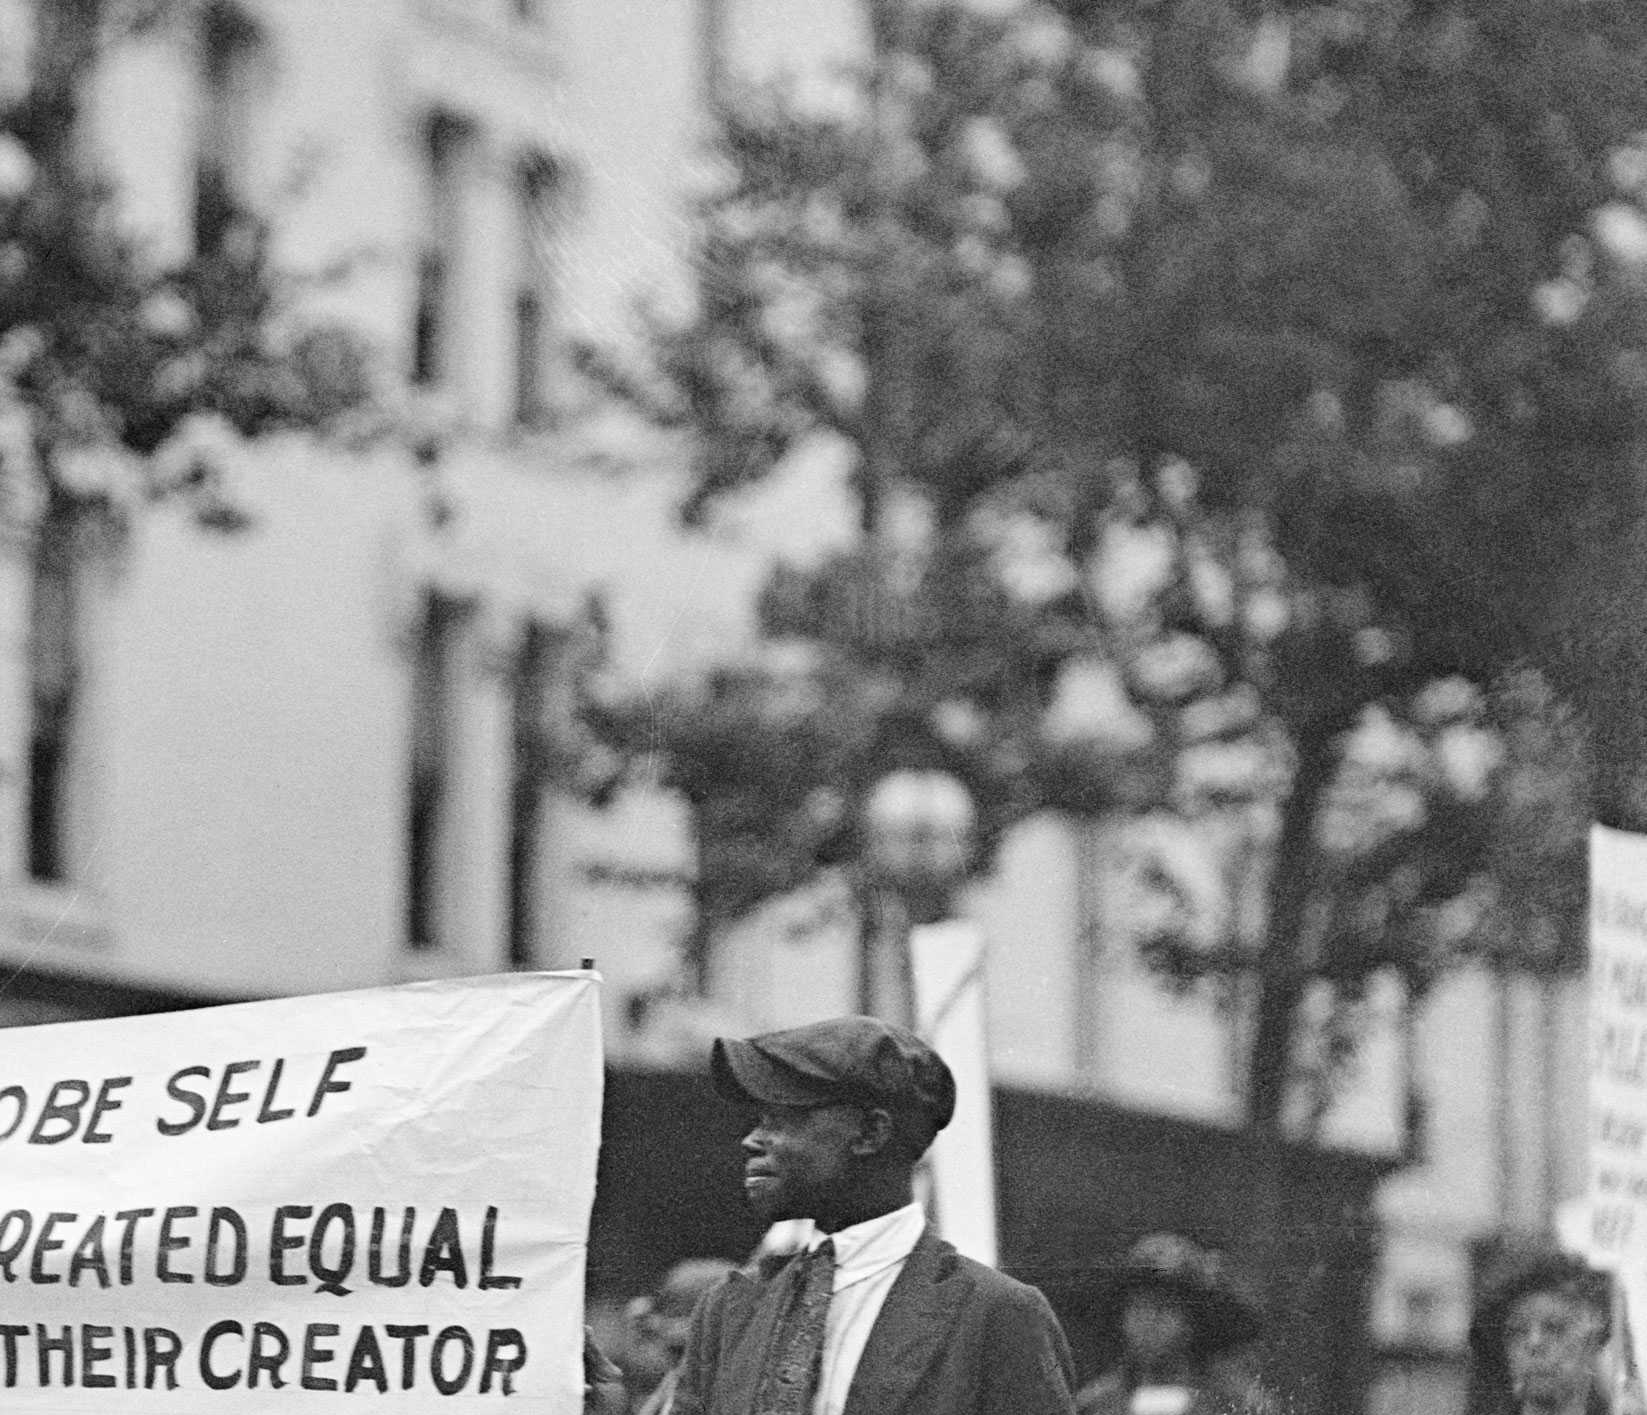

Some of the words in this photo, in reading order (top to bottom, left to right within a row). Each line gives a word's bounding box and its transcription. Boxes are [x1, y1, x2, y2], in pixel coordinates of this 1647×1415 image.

[29, 1076, 132, 1145] BE
[157, 1047, 366, 1136] SELF
[268, 1202, 523, 1298] EQUAL
[199, 1319, 527, 1397] CREATOR
